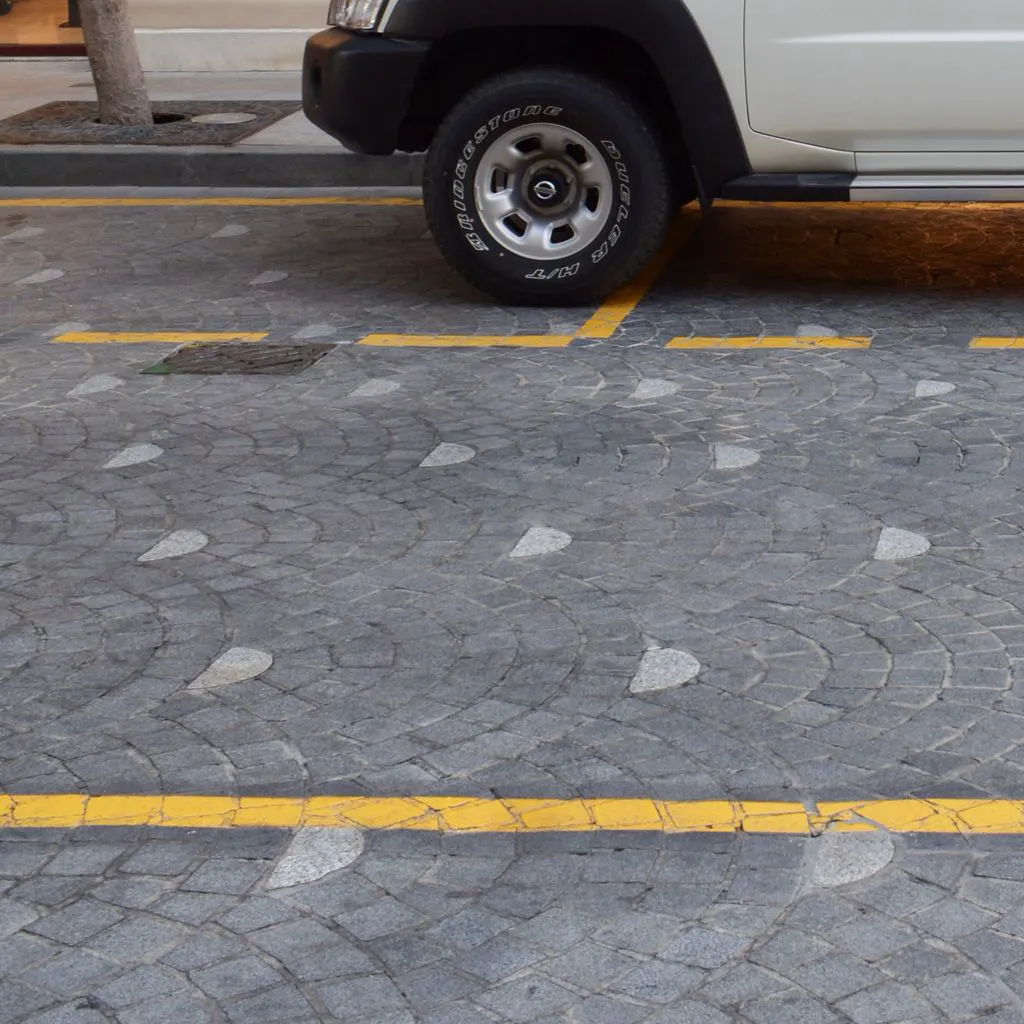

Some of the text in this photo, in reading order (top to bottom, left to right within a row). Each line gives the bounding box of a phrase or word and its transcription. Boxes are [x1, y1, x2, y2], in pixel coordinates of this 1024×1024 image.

[452, 104, 564, 252] BRIDGESTONE
[524, 139, 632, 280] DUELER H/T
